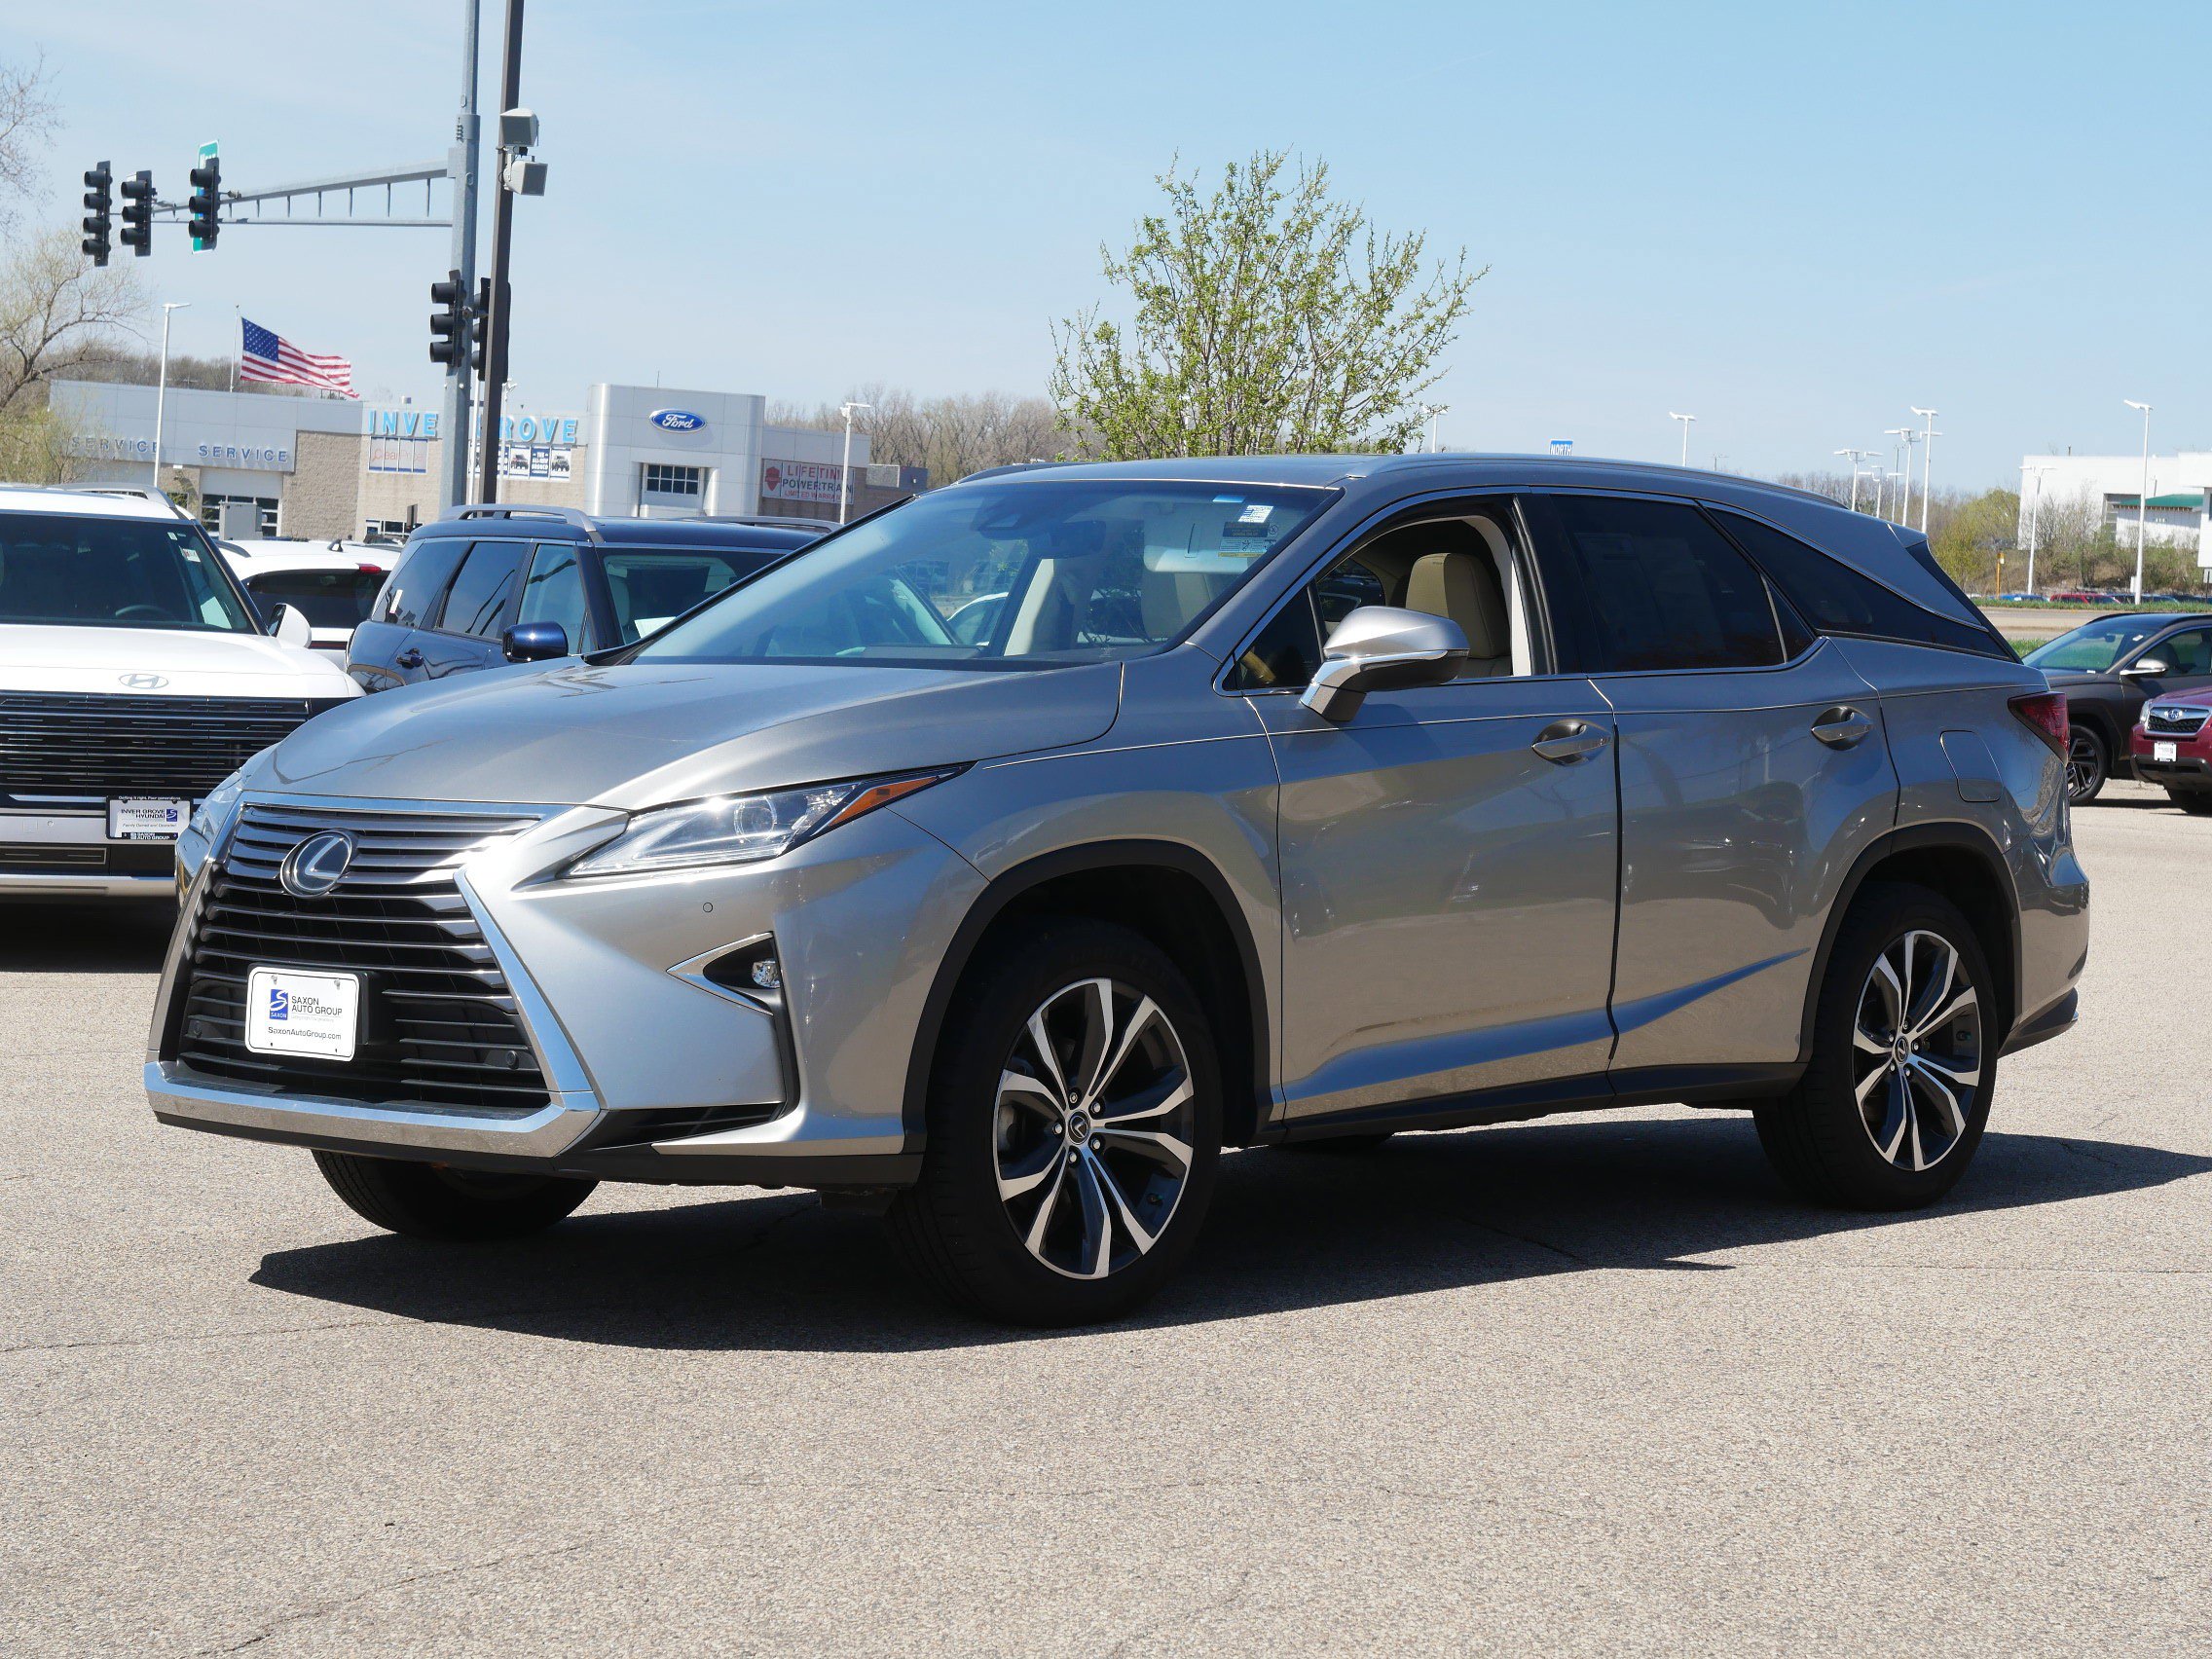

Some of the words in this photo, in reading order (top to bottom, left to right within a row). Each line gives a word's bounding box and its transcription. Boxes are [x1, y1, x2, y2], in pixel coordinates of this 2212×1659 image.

[368, 410, 438, 436] INVE
[476, 415, 576, 443] ROVE
[662, 414, 695, 428] Ford
[198, 445, 287, 462] SERVICE
[787, 463, 845, 480] LIFETIM
[782, 478, 853, 494] POWERTRAN
[291, 995, 319, 1006] SAXON
[291, 1004, 313, 1014] AUTO
[314, 1006, 343, 1015] GROUP
[268, 1026, 342, 1041] SaxonAutoGroup.com
